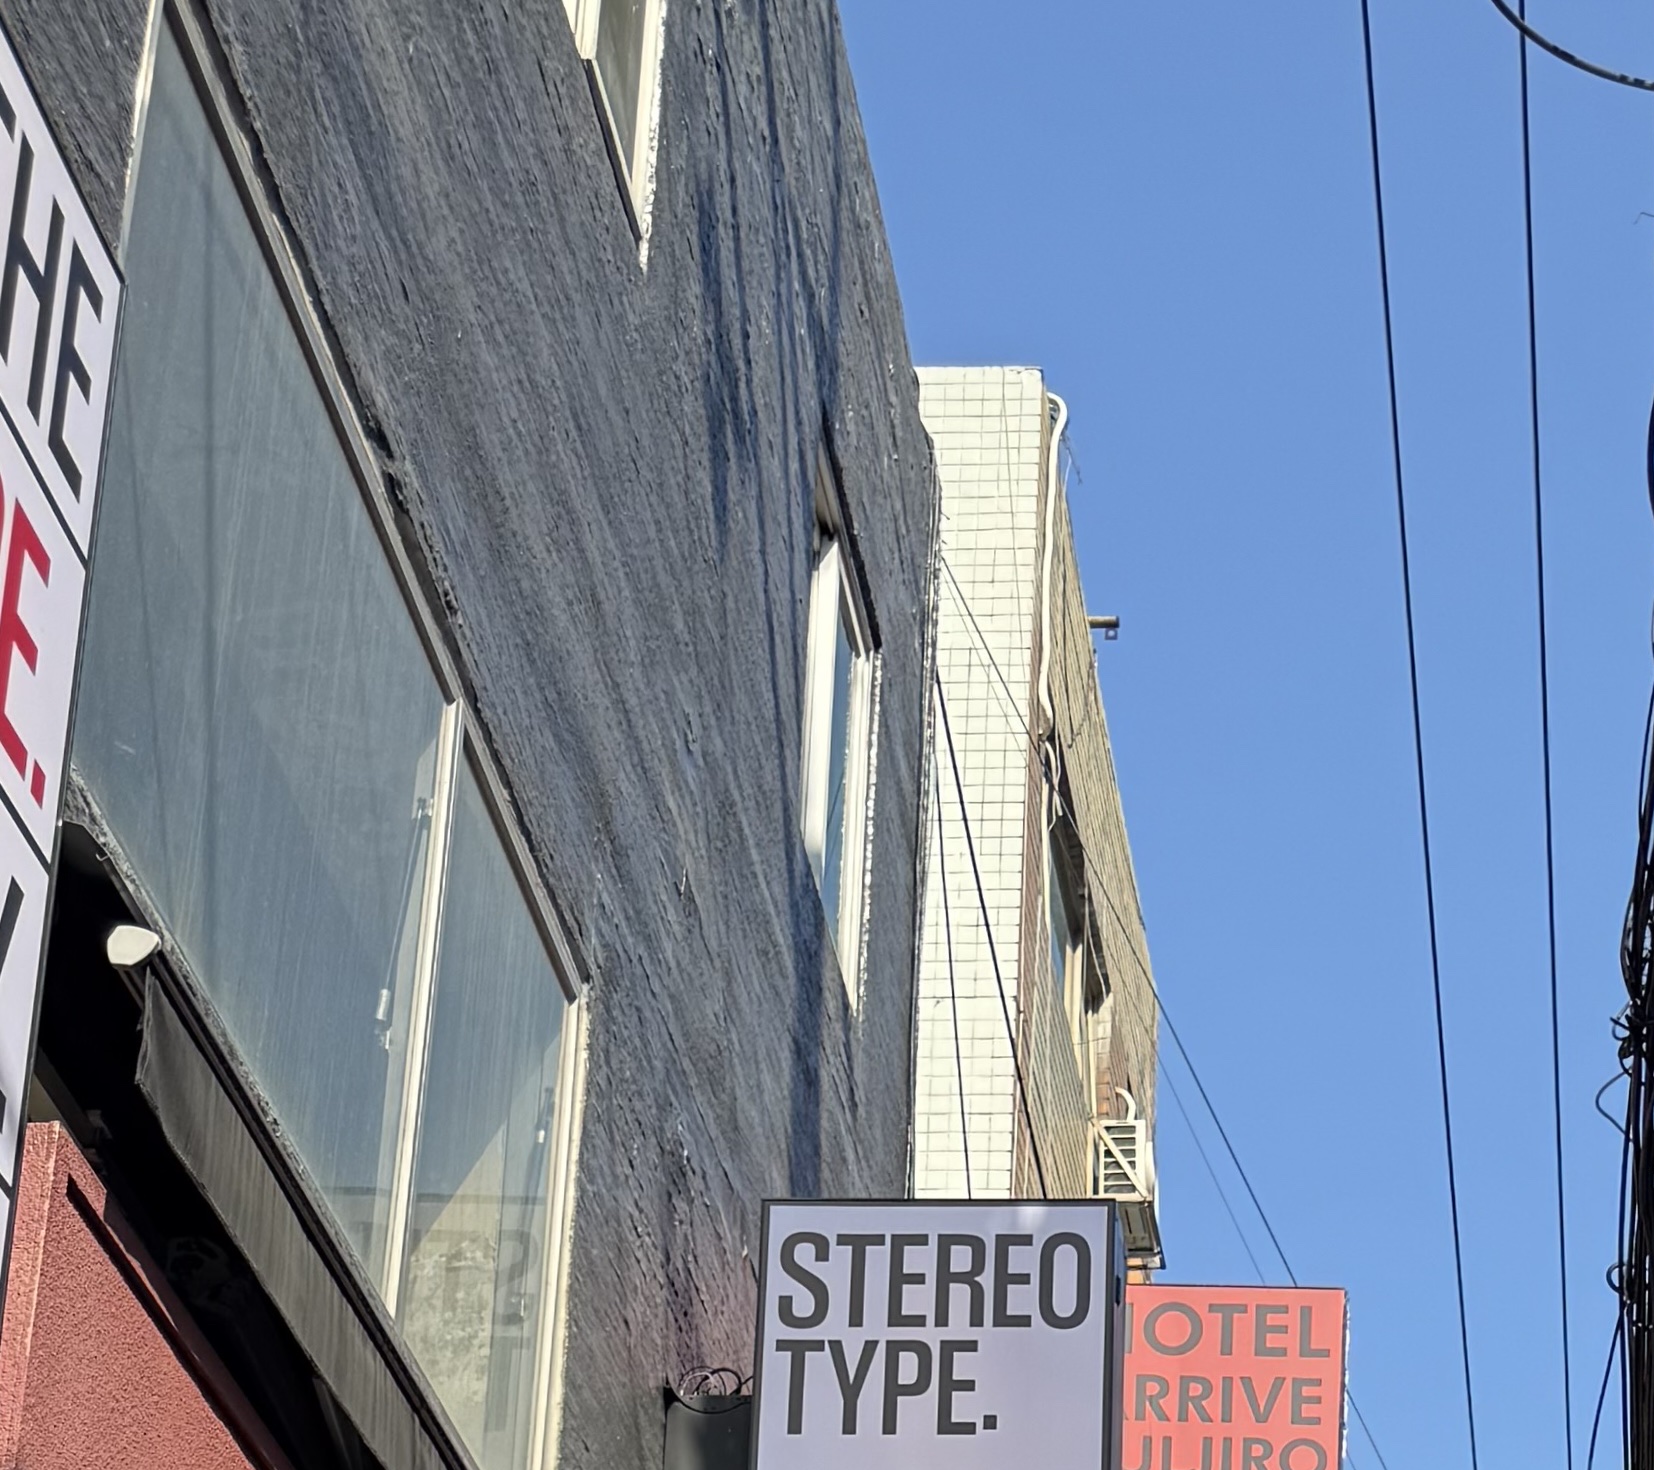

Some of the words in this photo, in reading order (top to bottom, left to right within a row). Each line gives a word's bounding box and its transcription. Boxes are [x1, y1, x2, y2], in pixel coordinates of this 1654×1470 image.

[0, 80, 103, 504] HE
[777, 1231, 1092, 1330] STEREO
[1123, 1301, 1331, 1359] OTEL
[775, 1339, 999, 1436] TYPE.
[1121, 1376, 1323, 1427] RRIVE
